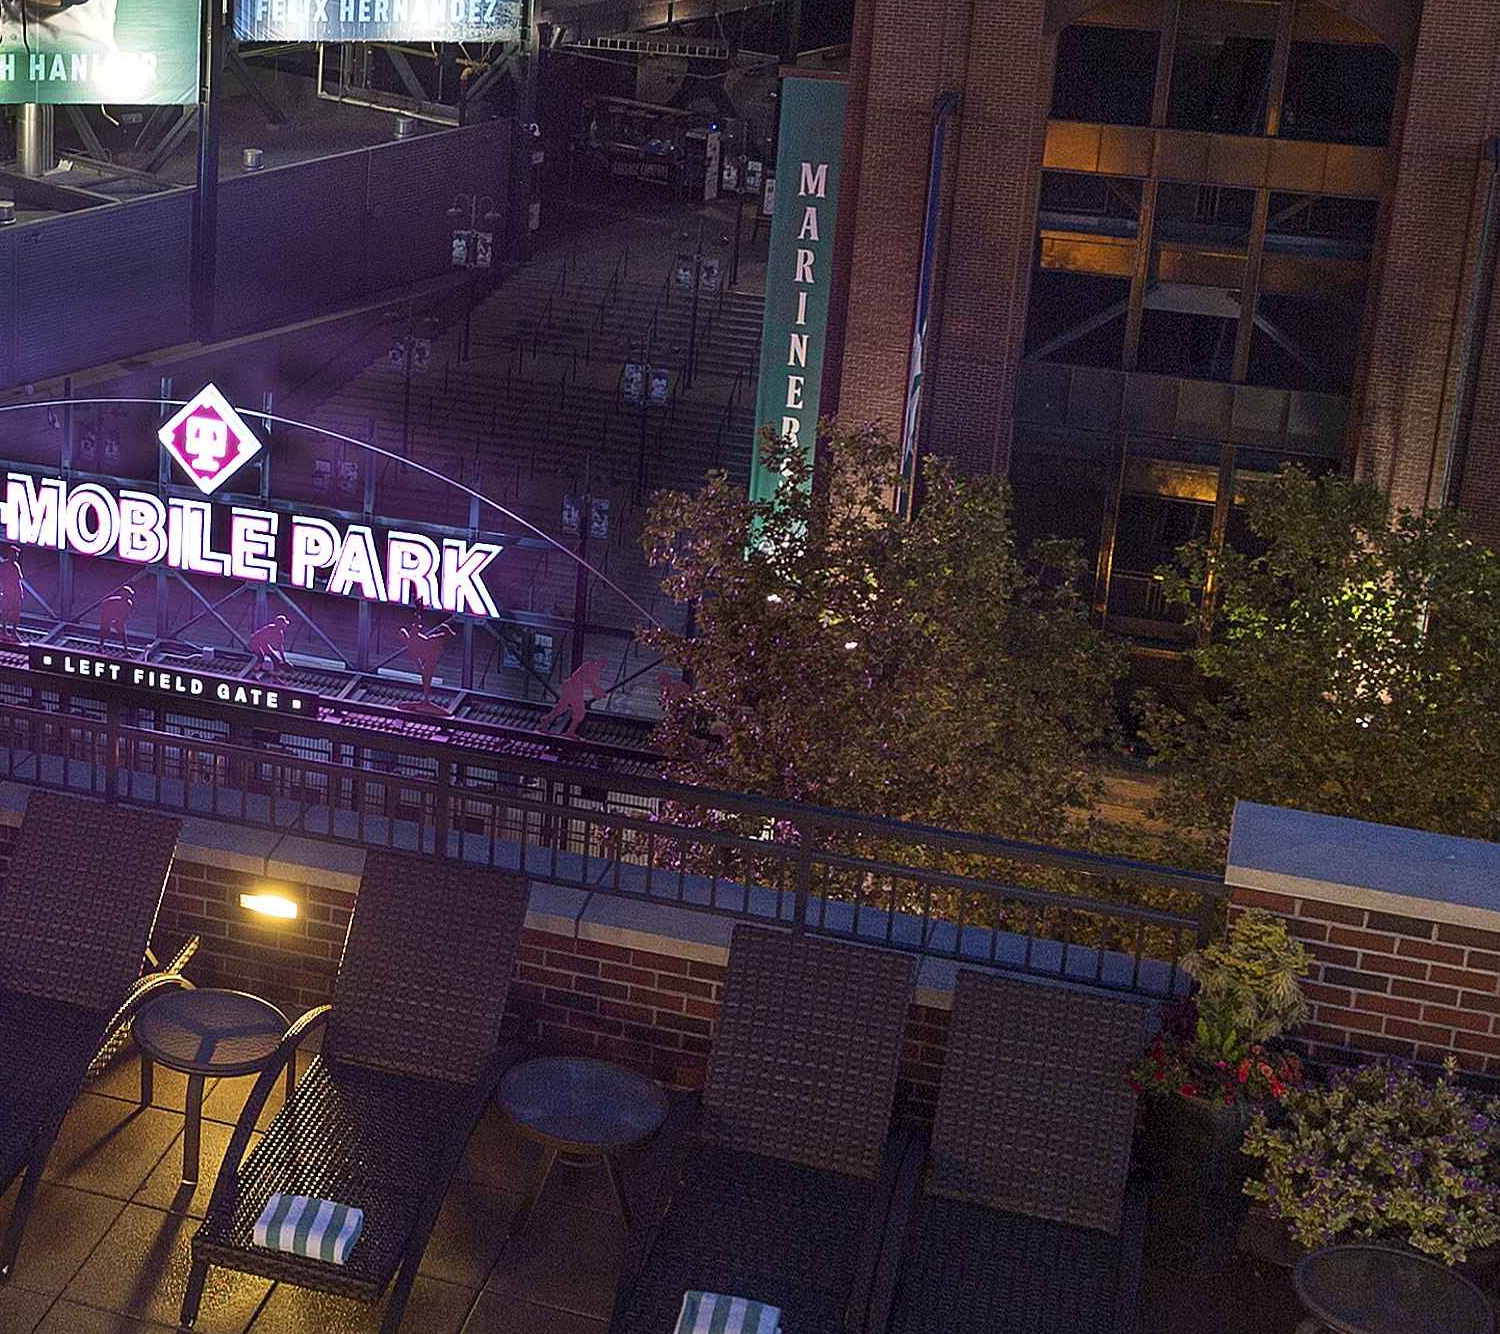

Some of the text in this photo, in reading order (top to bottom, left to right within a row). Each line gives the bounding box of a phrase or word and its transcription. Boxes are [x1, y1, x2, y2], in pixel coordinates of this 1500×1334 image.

[290, 513, 504, 618] PARK
[64, 655, 280, 709] LEFT FIELD GATE
